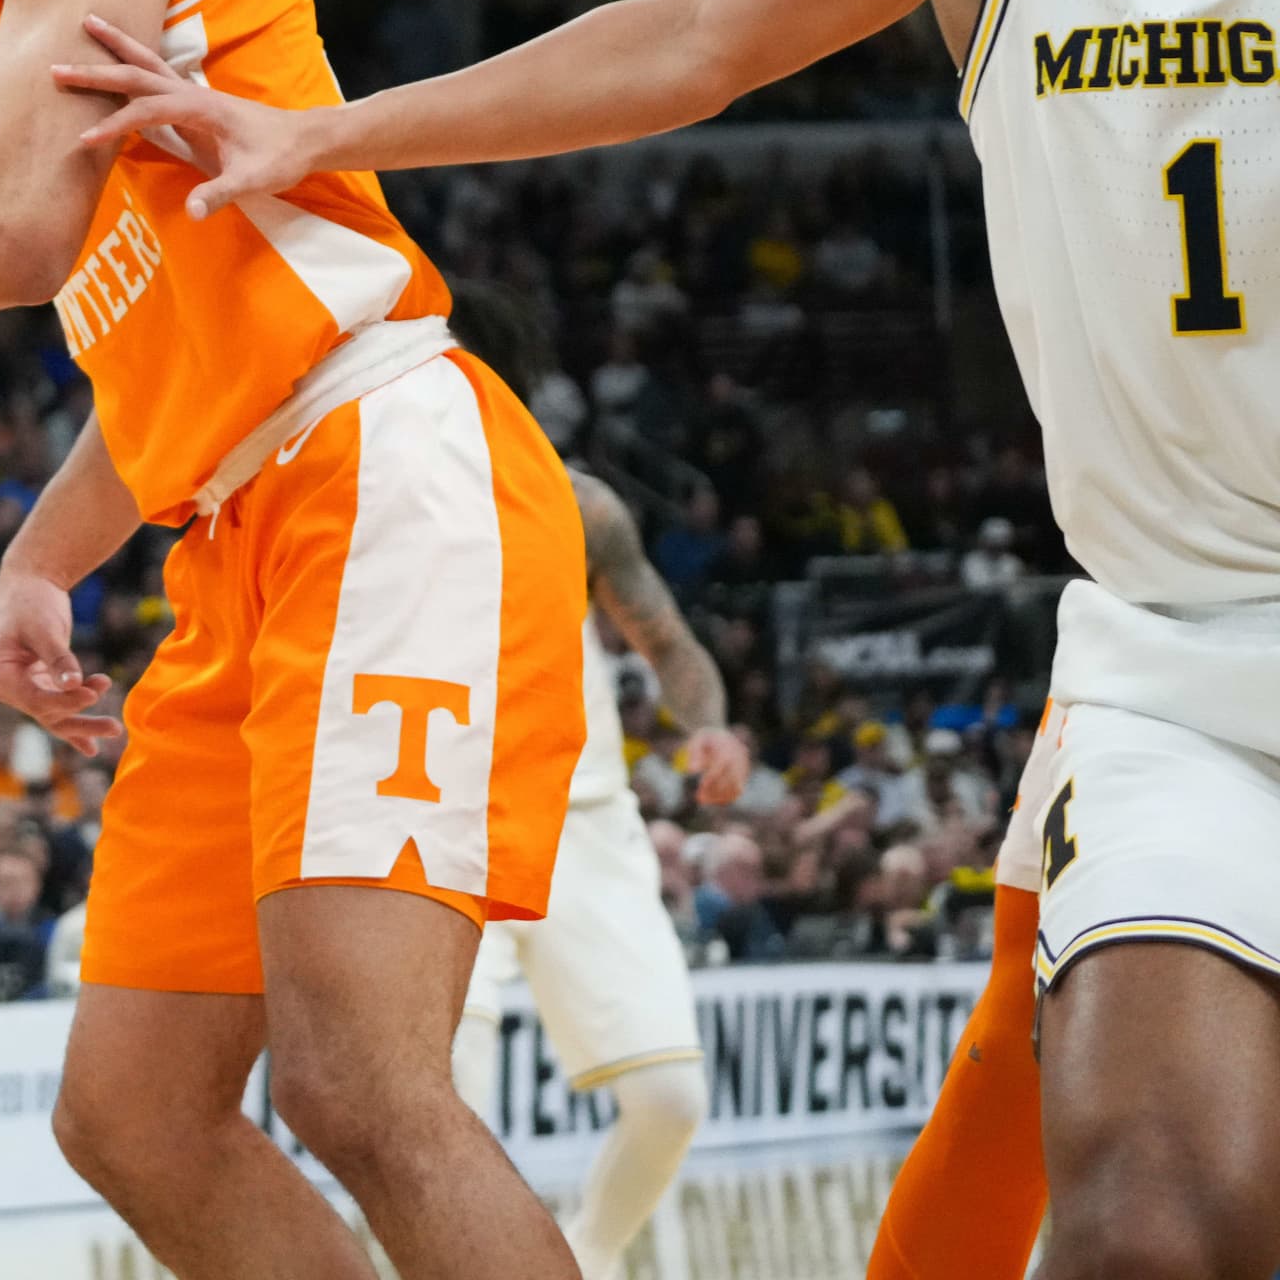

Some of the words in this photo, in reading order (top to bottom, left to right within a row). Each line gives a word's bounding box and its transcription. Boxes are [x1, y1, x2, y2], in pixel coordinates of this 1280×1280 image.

[1162, 138, 1246, 338] 1
[352, 673, 471, 804] T
[696, 988, 975, 1120] NIVERSIT
